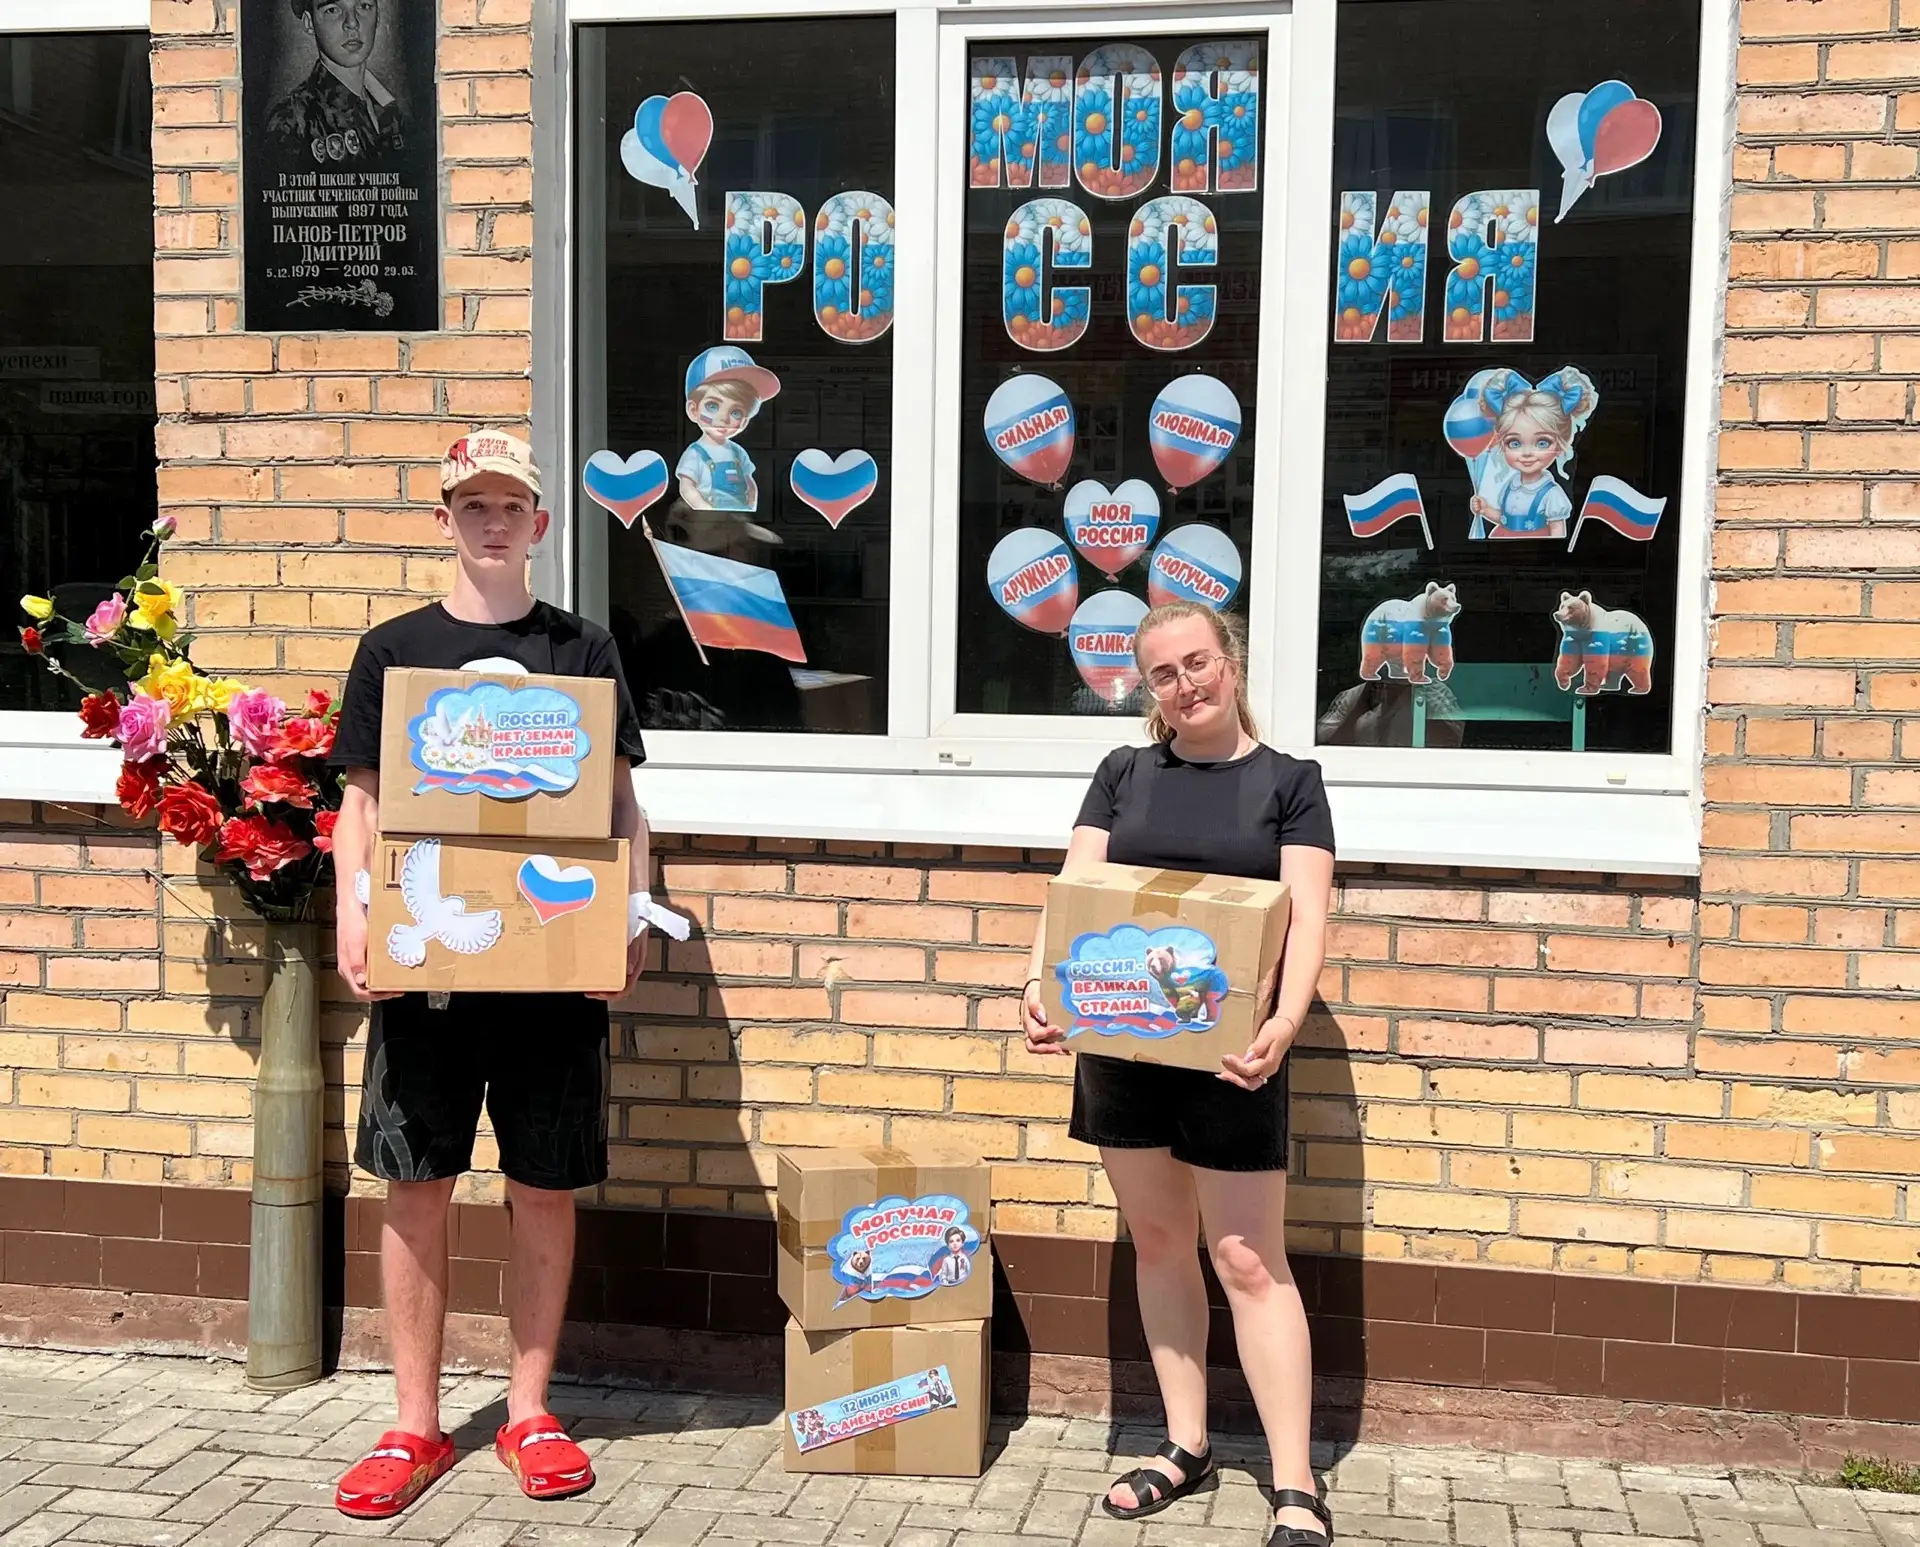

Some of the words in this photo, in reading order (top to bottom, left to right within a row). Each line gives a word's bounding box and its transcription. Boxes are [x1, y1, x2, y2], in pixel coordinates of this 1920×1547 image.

[969, 41, 1259, 200] МОЯ
[278, 174, 287, 187] В
[289, 171, 317, 187] ЭТОЙ
[319, 173, 357, 187] ШКОЛЕ
[358, 172, 400, 187] УЧИЛСЯ
[261, 188, 316, 203] УЧАСТНИК
[317, 186, 379, 202] ЧЕЧЕНСКОЙ
[380, 186, 419, 202] ВОЙНЫ
[271, 205, 339, 219] ВЫПУСКНИК
[347, 204, 376, 218] 1997
[380, 204, 409, 219] ГОДА
[272, 223, 407, 244] ПАНОВ-ПЕТРОВ
[301, 243, 382, 264] ДМИТРИЙ
[266, 265, 320, 279] 5.12.1979
[343, 264, 379, 278] 2000
[383, 266, 418, 278] 29.03.
[112, 389, 153, 410] гор
[996, 407, 1068, 450] СИЛЬНАЯ!
[1155, 412, 1233, 448] ЛЮБИМАЯ!
[1091, 504, 1131, 522] МОЯ
[1076, 527, 1146, 545] РОССИЯ
[1003, 556, 1069, 603] ДРУЖНАЯ!
[1156, 555, 1228, 602] МОГУЧАЯ!
[1076, 634, 1135, 653] ВЕЛИКА
[499, 712, 567, 727] РОССИЯ
[493, 730, 523, 743] НЕТ
[526, 729, 574, 742] ЗЕМЛИ
[494, 743, 575, 758] КРАСИВЕЙ!
[1073, 980, 1149, 994] ВЕЛИКАЯ
[1079, 1000, 1148, 1014] СТРАНА!
[852, 1206, 956, 1237] МОГУЧАЯ
[866, 1224, 944, 1249] РОССИЯ!
[842, 1400, 858, 1414] 12
[859, 1388, 899, 1409] ИЮНЯ
[828, 1422, 840, 1434] С
[840, 1413, 877, 1432] ДНЁМ
[878, 1394, 930, 1420] РОССИИ!
